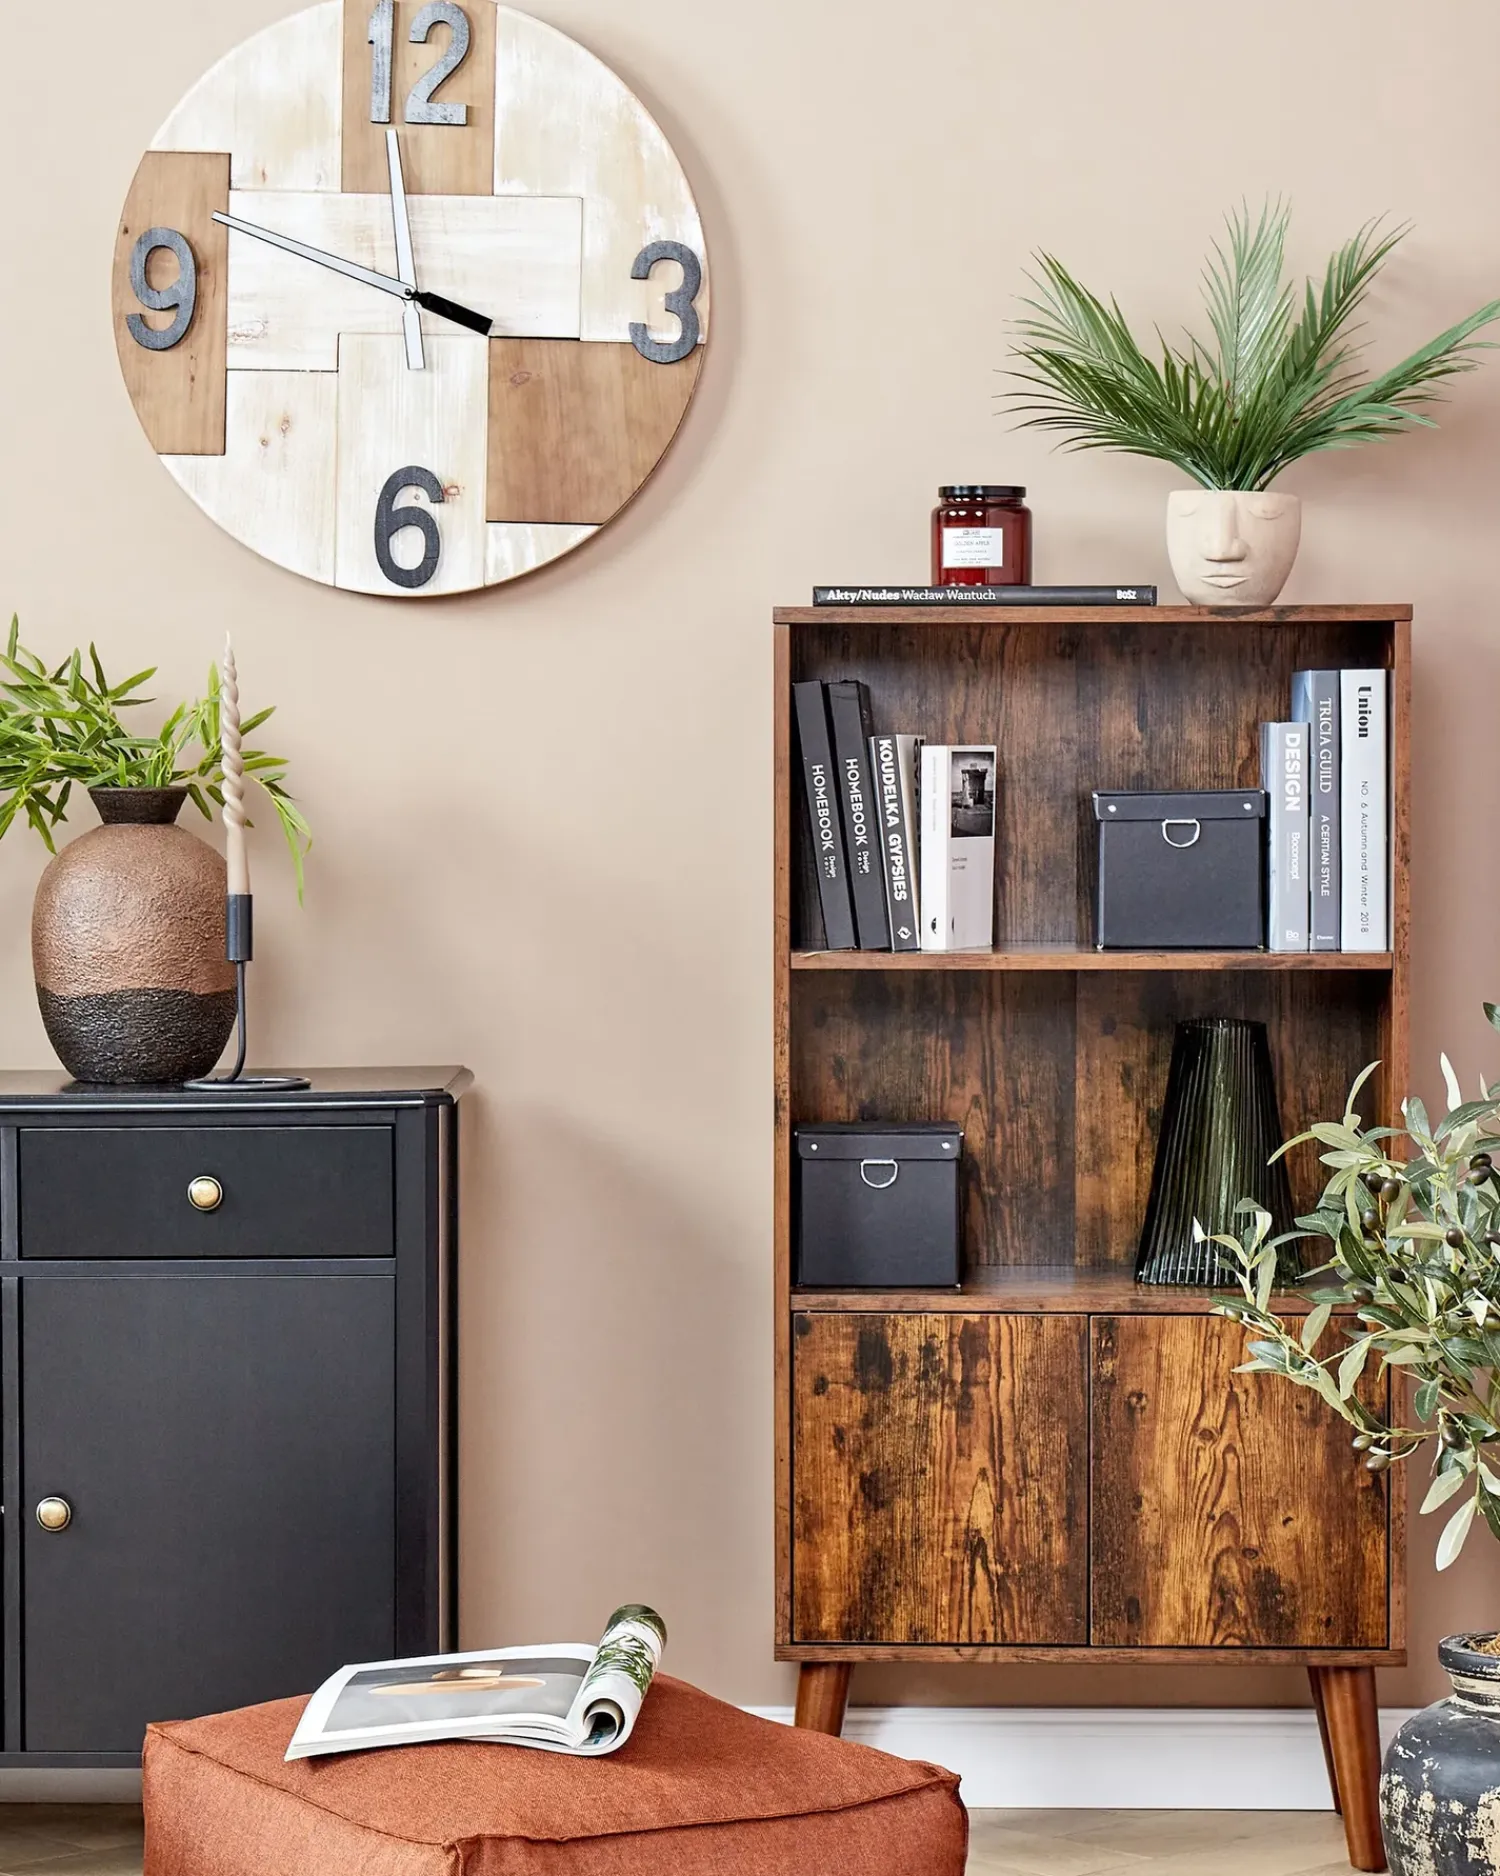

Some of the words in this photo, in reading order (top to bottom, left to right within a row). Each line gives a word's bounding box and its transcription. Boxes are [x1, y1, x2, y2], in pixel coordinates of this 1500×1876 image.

[368, 0, 470, 125] 12
[126, 227, 197, 351] 9
[629, 240, 702, 364] 3
[374, 465, 444, 588] 6
[826, 589, 900, 603] Akty/Nudes
[901, 589, 943, 600] Wacław
[946, 589, 996, 600] Wantuch
[1319, 697, 1332, 746] TRICIA
[1358, 686, 1372, 738] Union
[845, 758, 869, 846] HOMEBOOK
[878, 738, 899, 828] KOUDELKA
[1285, 733, 1300, 811] DESIGN
[1319, 748, 1332, 793] GUILD
[811, 764, 835, 851] HOMEBOOK
[887, 833, 907, 901] GYPSIES
[1321, 824, 1330, 865] CERTIAN
[1321, 867, 1330, 897] STYLE
[1361, 912, 1369, 933] 2018
